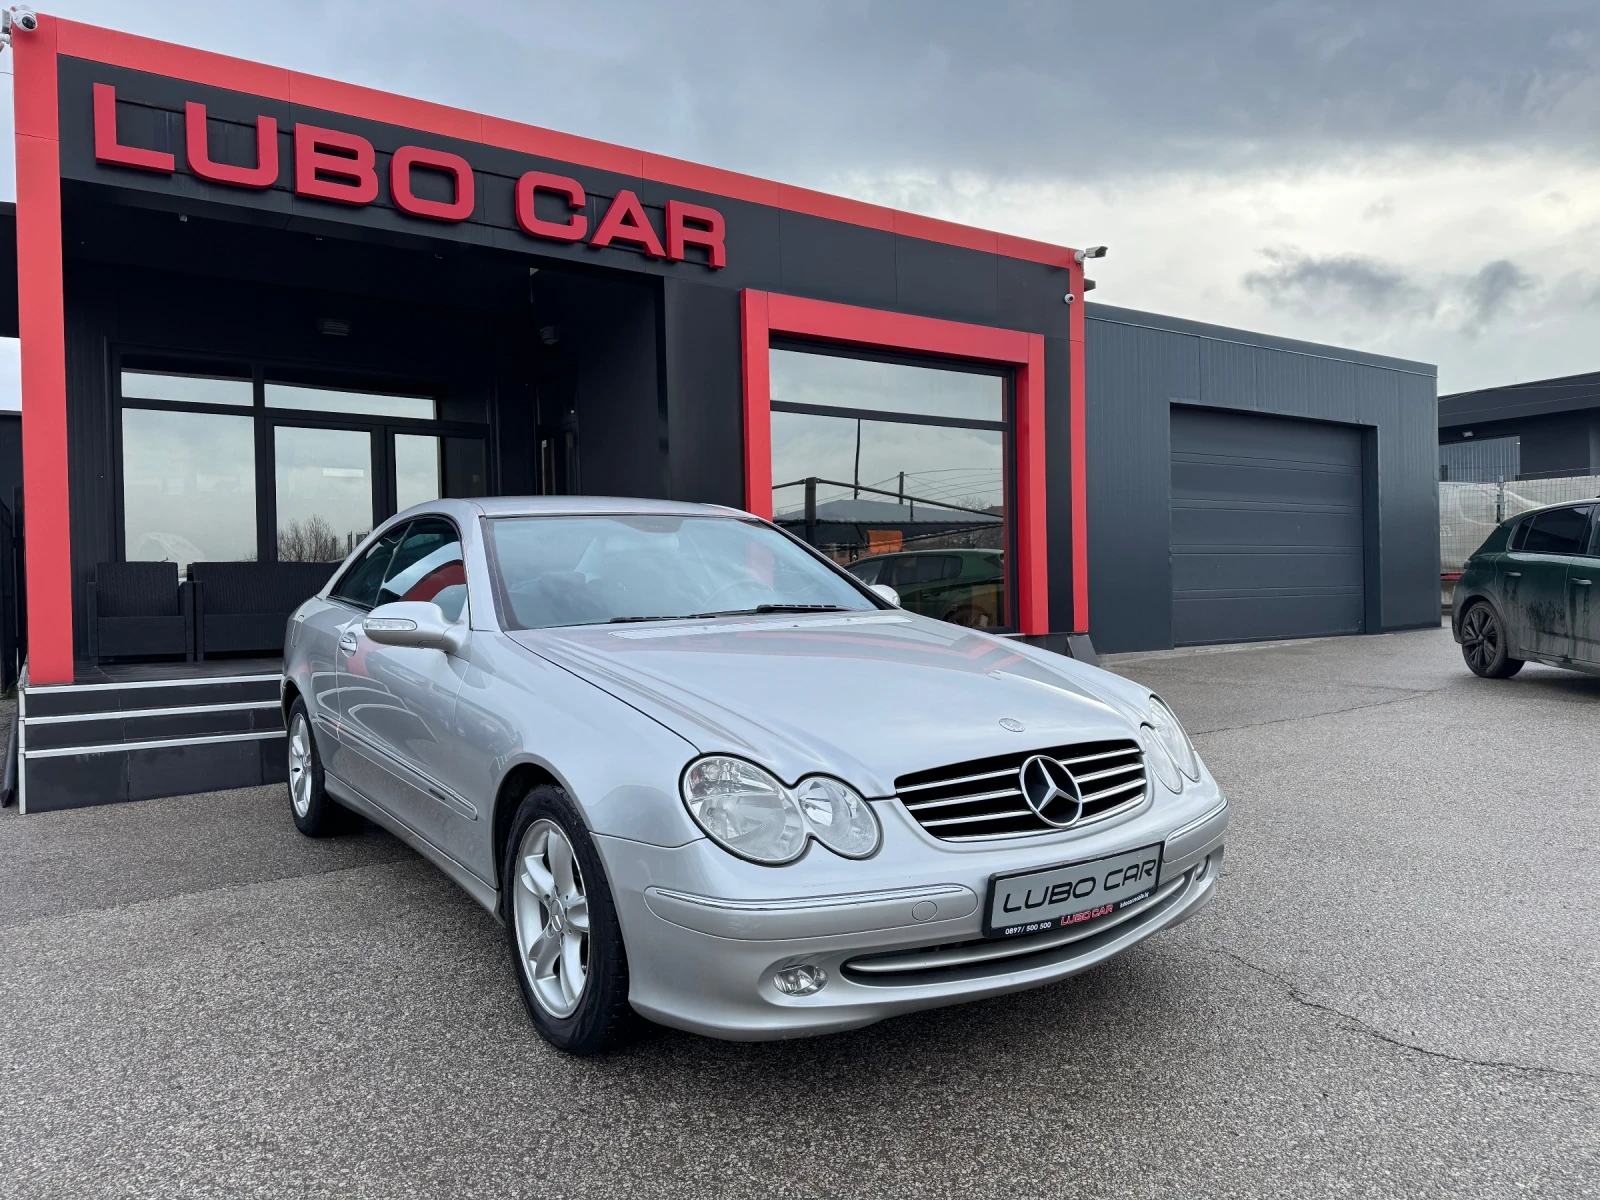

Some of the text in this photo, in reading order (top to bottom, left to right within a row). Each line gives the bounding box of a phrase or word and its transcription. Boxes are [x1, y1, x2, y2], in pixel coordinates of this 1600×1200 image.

[93, 82, 727, 270] LUBO CAR
[1003, 876, 1097, 913] LUBO
[1103, 859, 1157, 892] CAR
[1004, 921, 1051, 935] 0897/ 500 500
[1061, 904, 1113, 926] LUBO CAR
